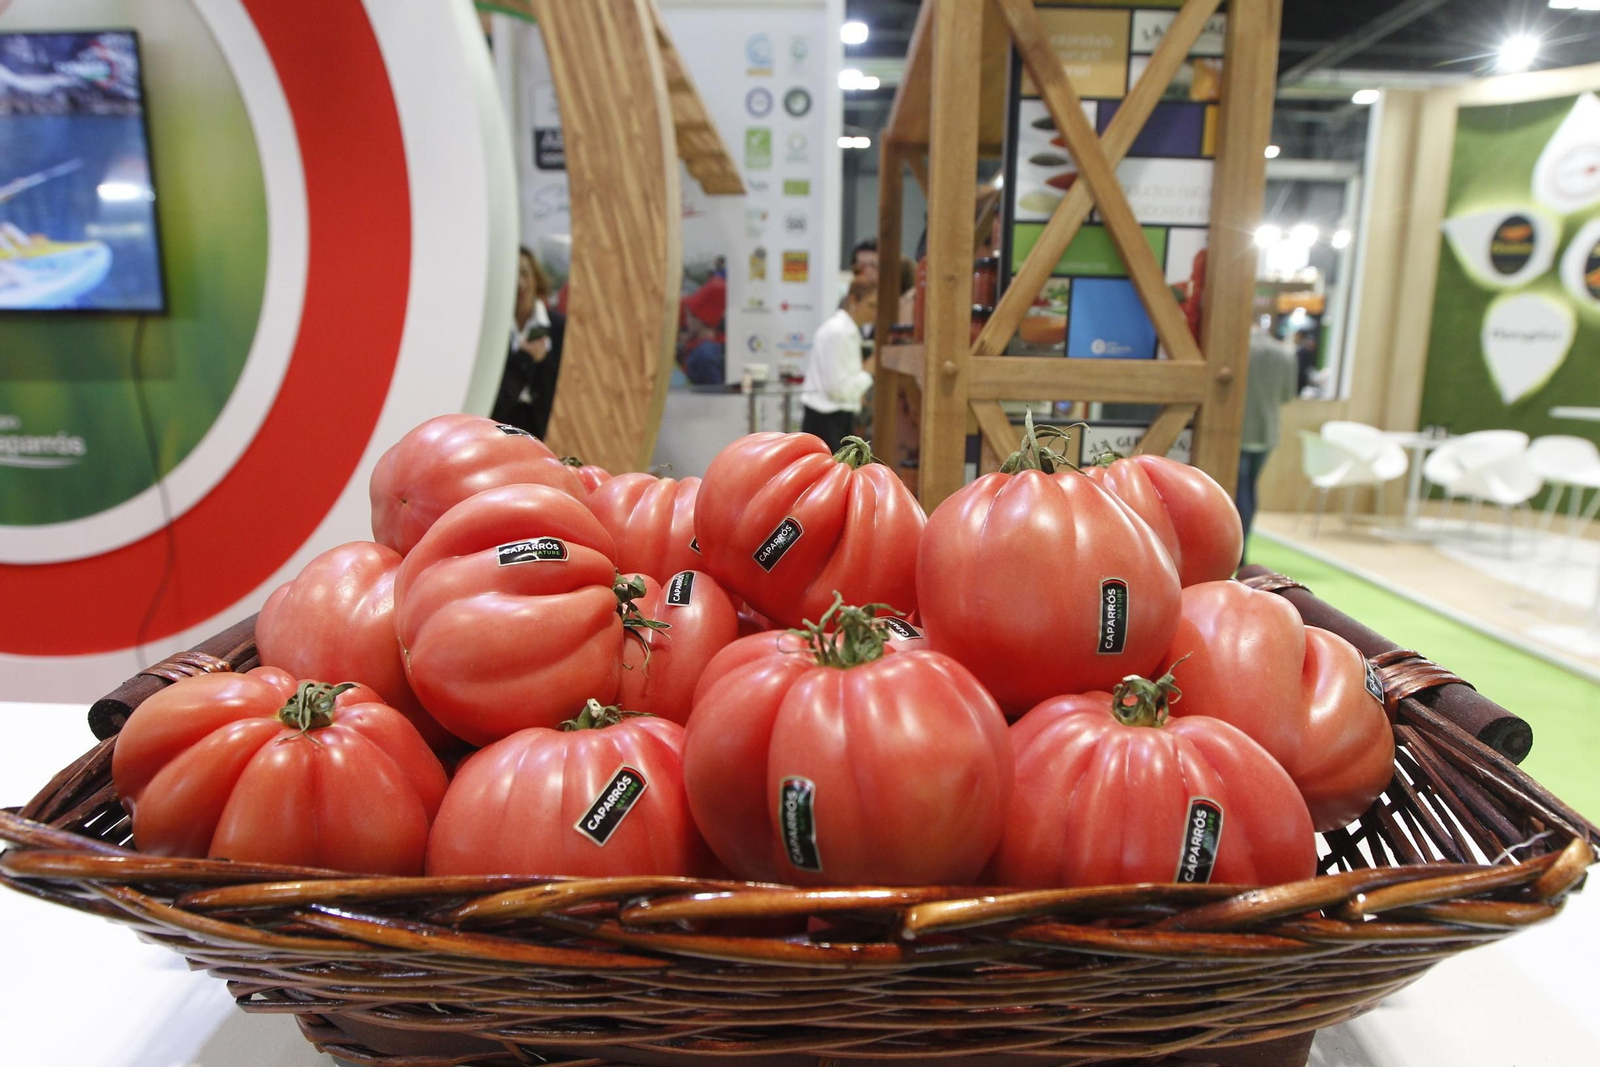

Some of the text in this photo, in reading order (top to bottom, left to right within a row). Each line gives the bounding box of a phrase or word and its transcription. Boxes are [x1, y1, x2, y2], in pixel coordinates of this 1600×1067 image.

[502, 541, 560, 555] CAPARRÓS
[758, 524, 793, 562] CAPARRÓS
[1104, 588, 1117, 650] CAPARRÓS
[586, 775, 632, 831] CAPARRÓS
[615, 781, 639, 809] NATURE
[785, 789, 804, 864] CAPARRÓS
[1184, 809, 1208, 883] CAPARRÓS
[1202, 812, 1216, 849] NATURE
